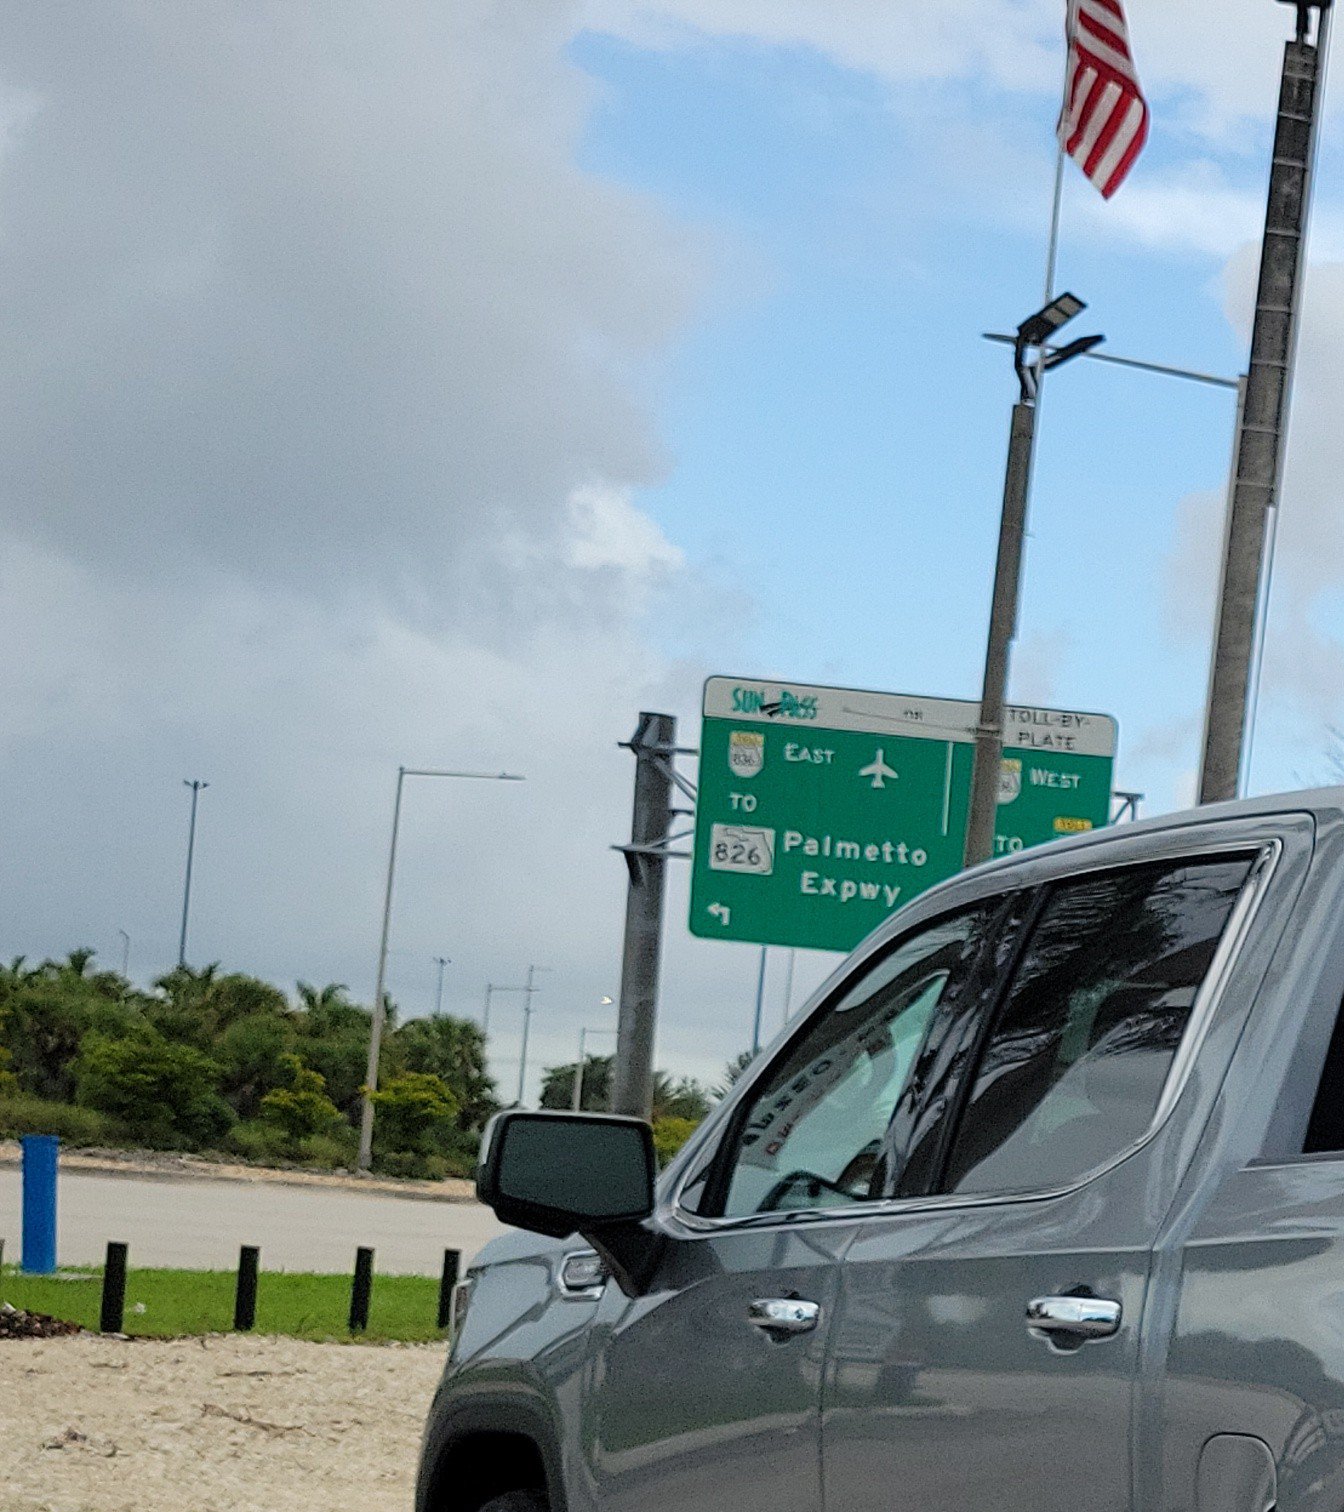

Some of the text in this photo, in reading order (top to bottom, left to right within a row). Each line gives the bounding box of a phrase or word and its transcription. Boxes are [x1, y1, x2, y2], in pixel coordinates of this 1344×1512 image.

[1018, 731, 1075, 749] PLATE
[783, 742, 834, 764] EAST
[1029, 766, 1080, 789] WEST
[729, 791, 757, 813] TO
[714, 842, 761, 866] 826
[783, 830, 927, 867] Palmetto
[994, 834, 1023, 852] TO
[801, 869, 900, 908] Expwy
